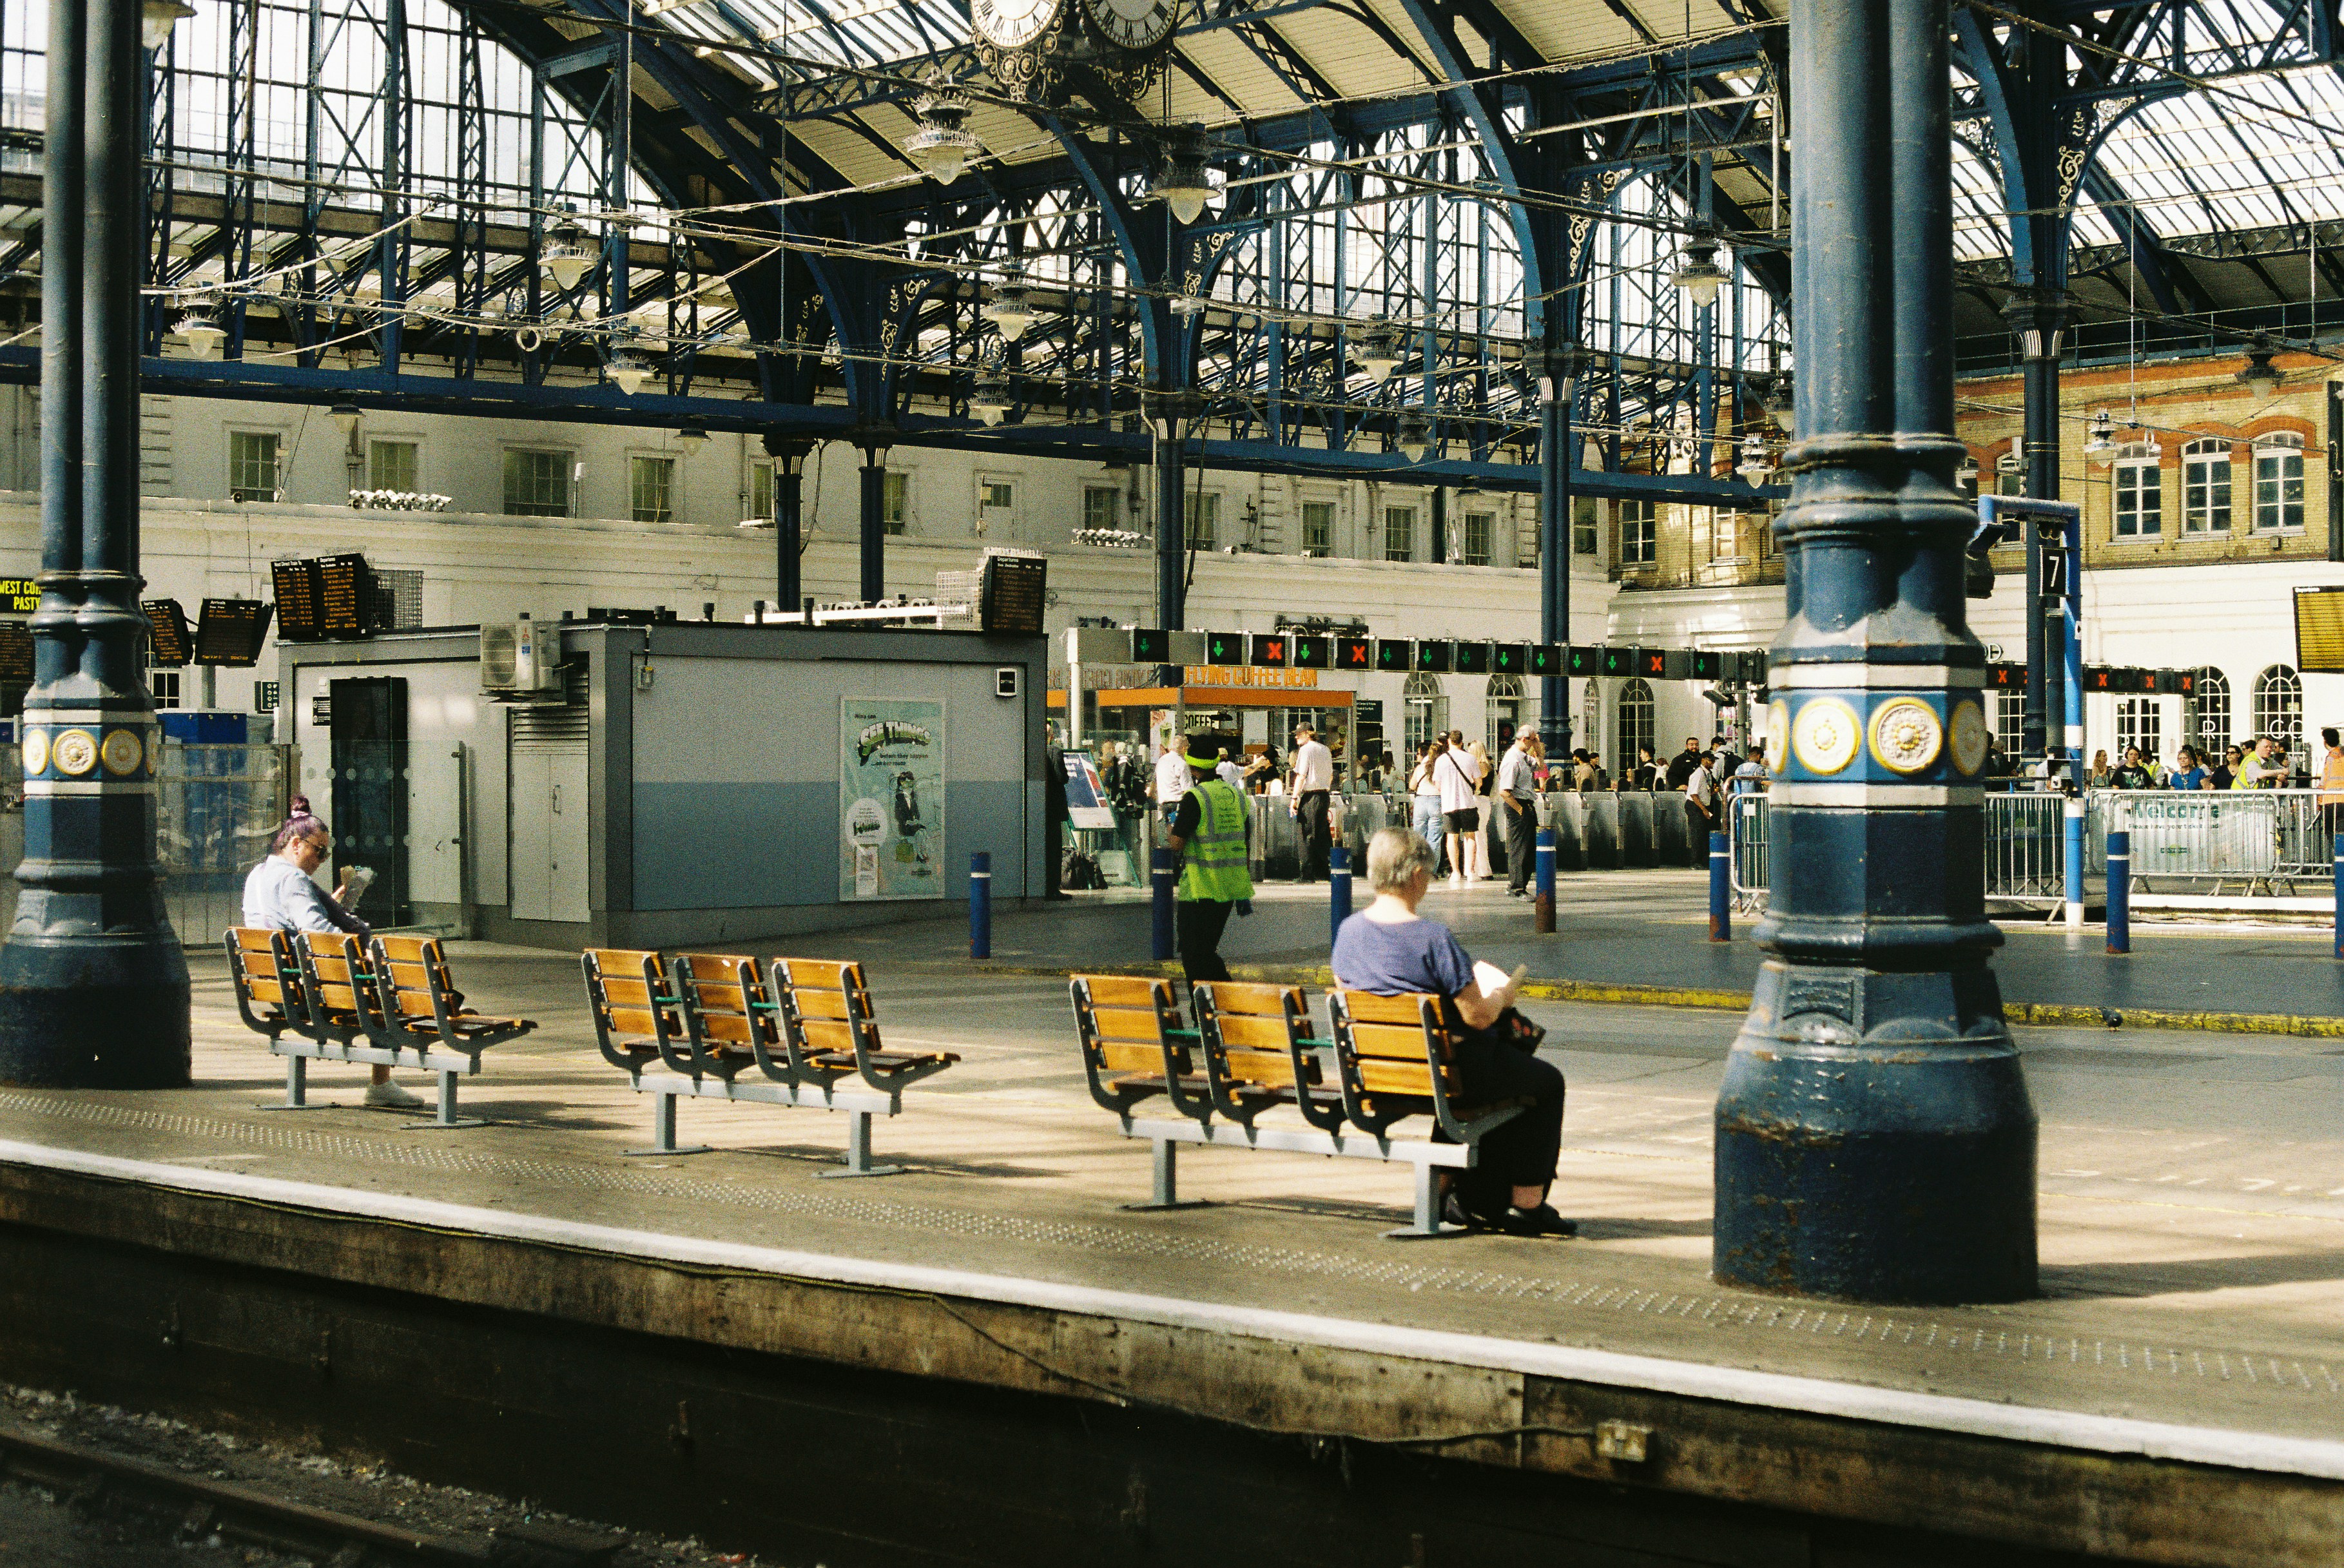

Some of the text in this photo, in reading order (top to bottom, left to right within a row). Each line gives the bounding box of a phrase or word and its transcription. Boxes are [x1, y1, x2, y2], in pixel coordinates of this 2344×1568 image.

[2048, 556, 2060, 587] 7
[1185, 665, 1317, 686] FLYING COFFEE BEAN
